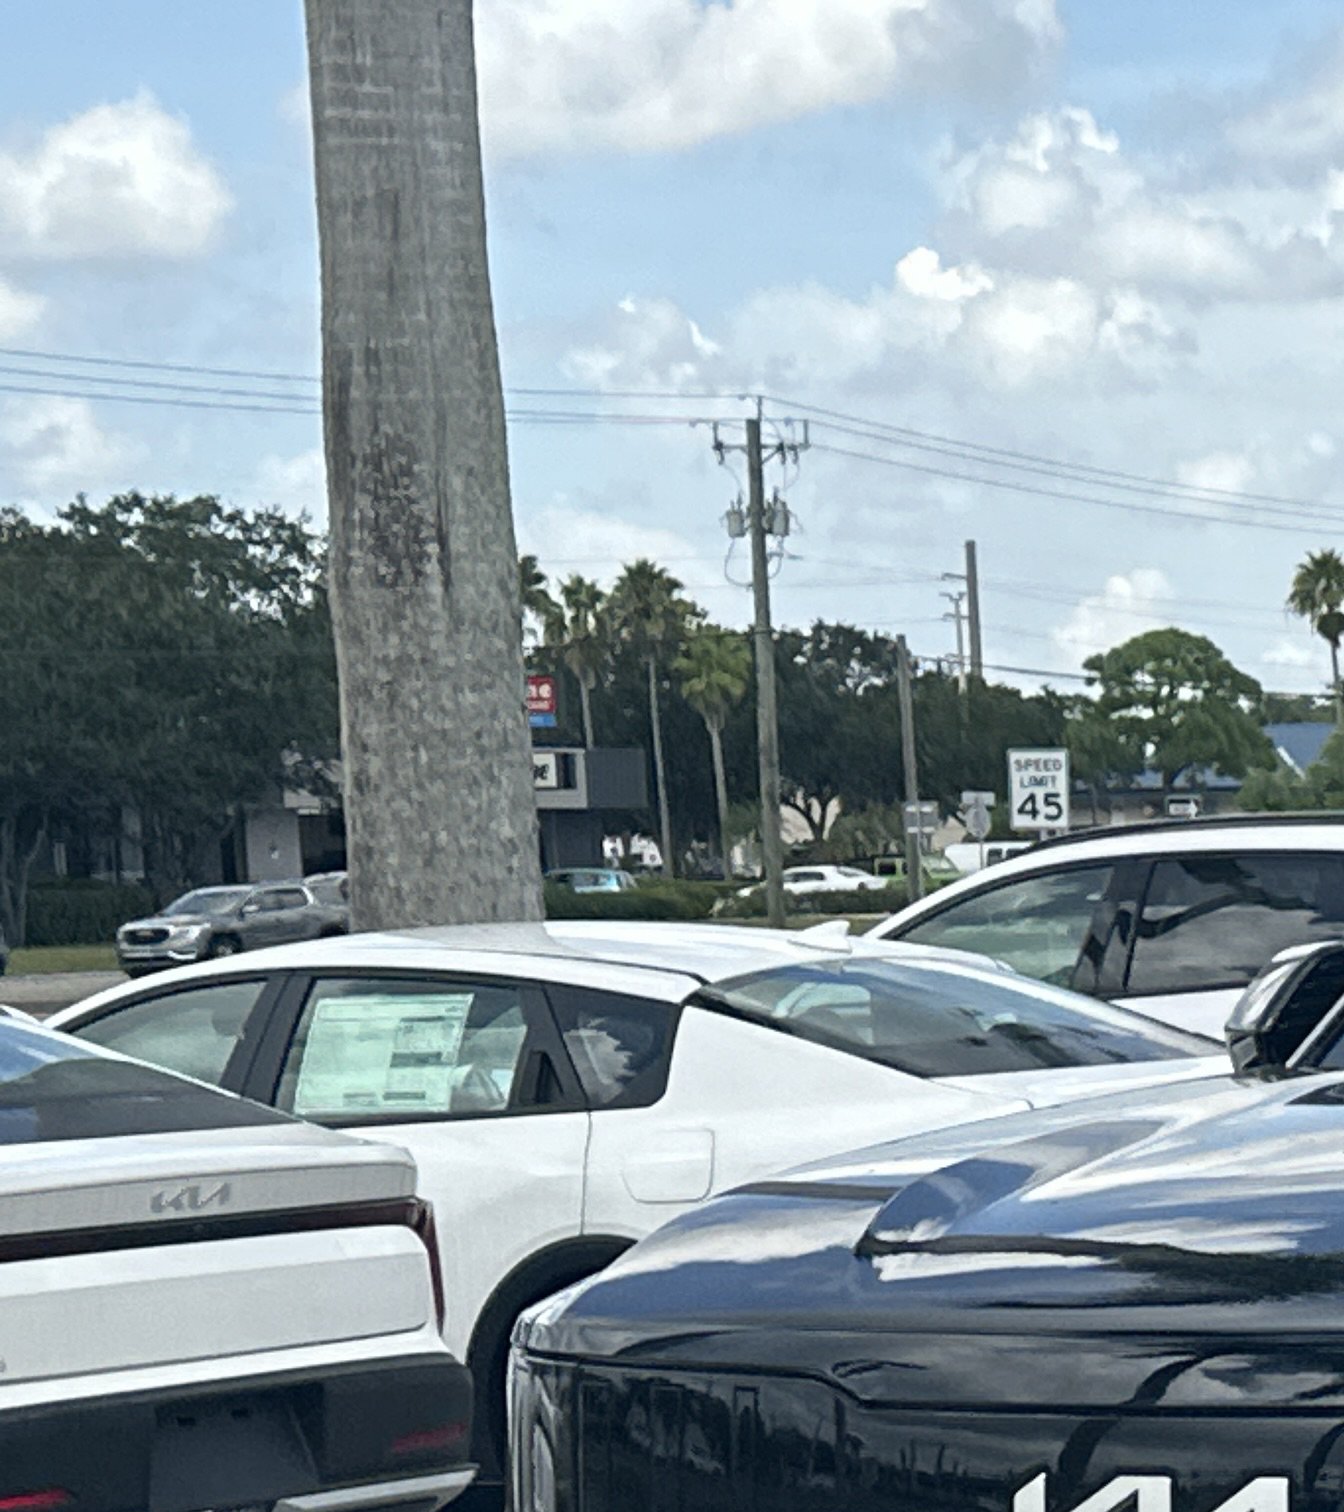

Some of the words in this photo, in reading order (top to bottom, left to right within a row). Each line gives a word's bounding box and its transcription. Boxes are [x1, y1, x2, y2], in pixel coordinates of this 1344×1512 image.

[1014, 757, 1062, 772] SPEED
[1019, 775, 1057, 788] LIMIT
[1017, 792, 1063, 821] 45
[150, 1182, 231, 1214] KIA
